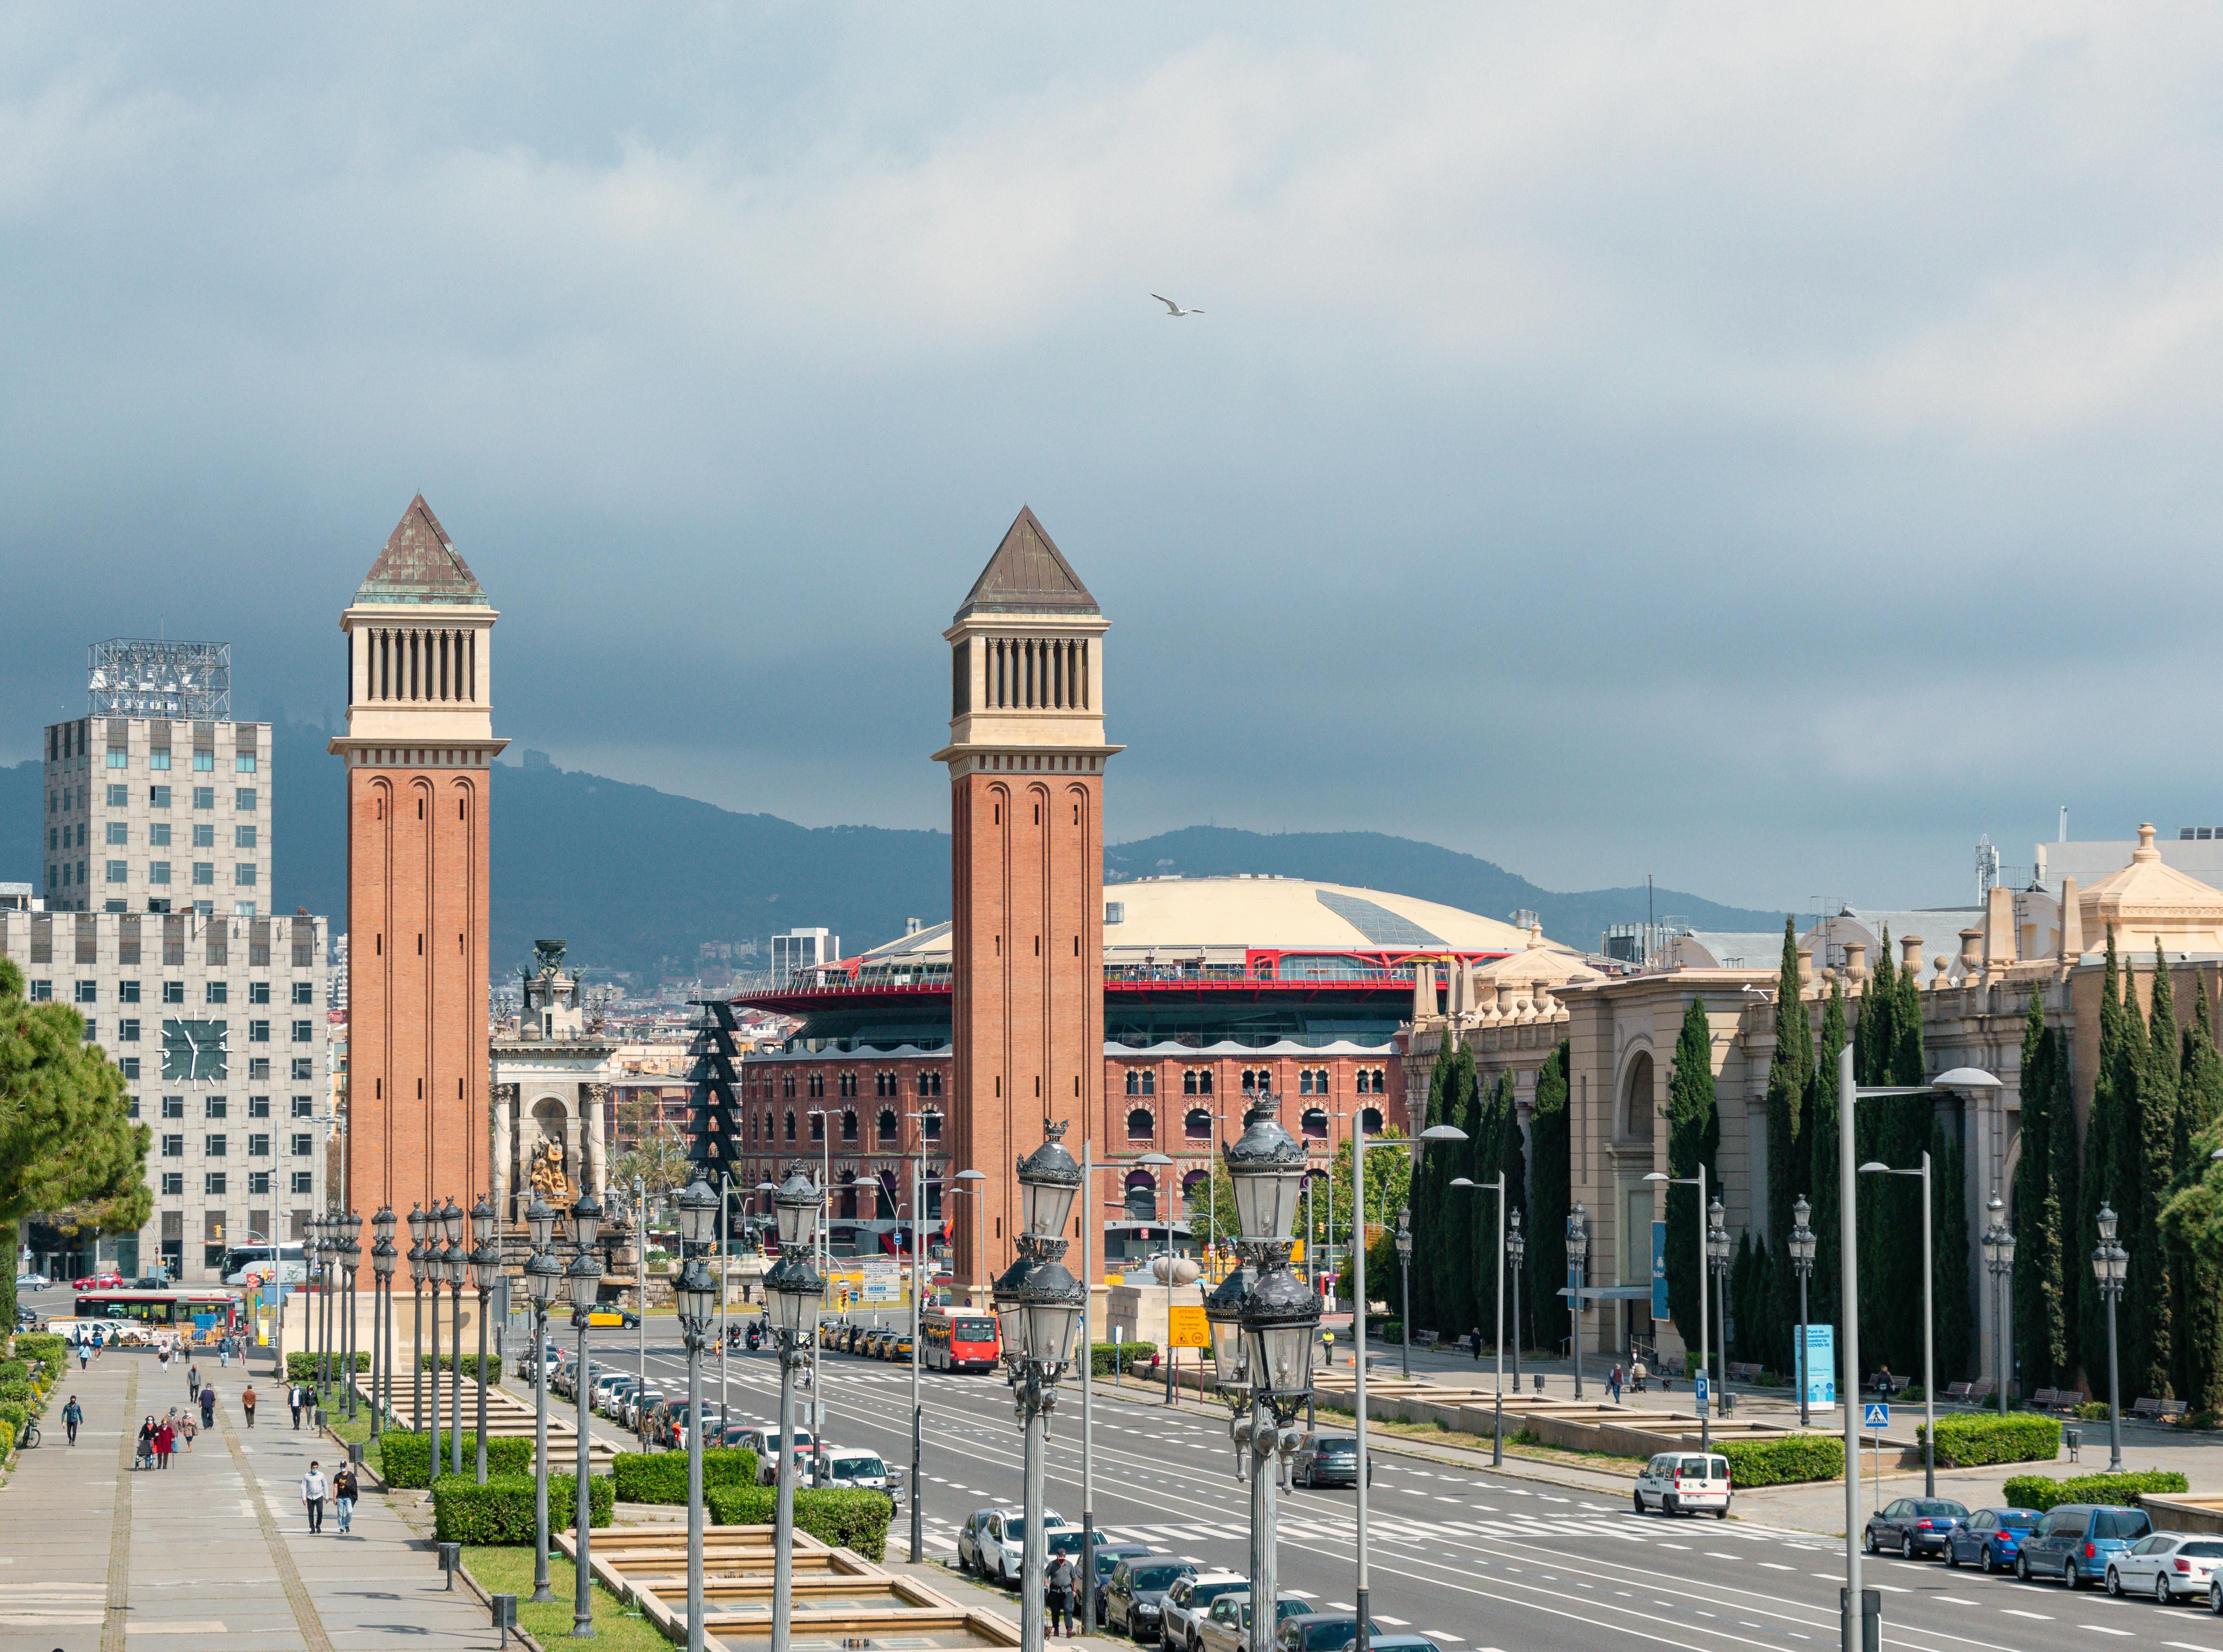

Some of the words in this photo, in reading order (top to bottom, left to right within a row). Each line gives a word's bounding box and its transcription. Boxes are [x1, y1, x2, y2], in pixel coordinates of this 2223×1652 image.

[129, 642, 218, 656] CATALONIA
[117, 662, 229, 687] PLAZA
[1697, 1380, 1706, 1397] P
